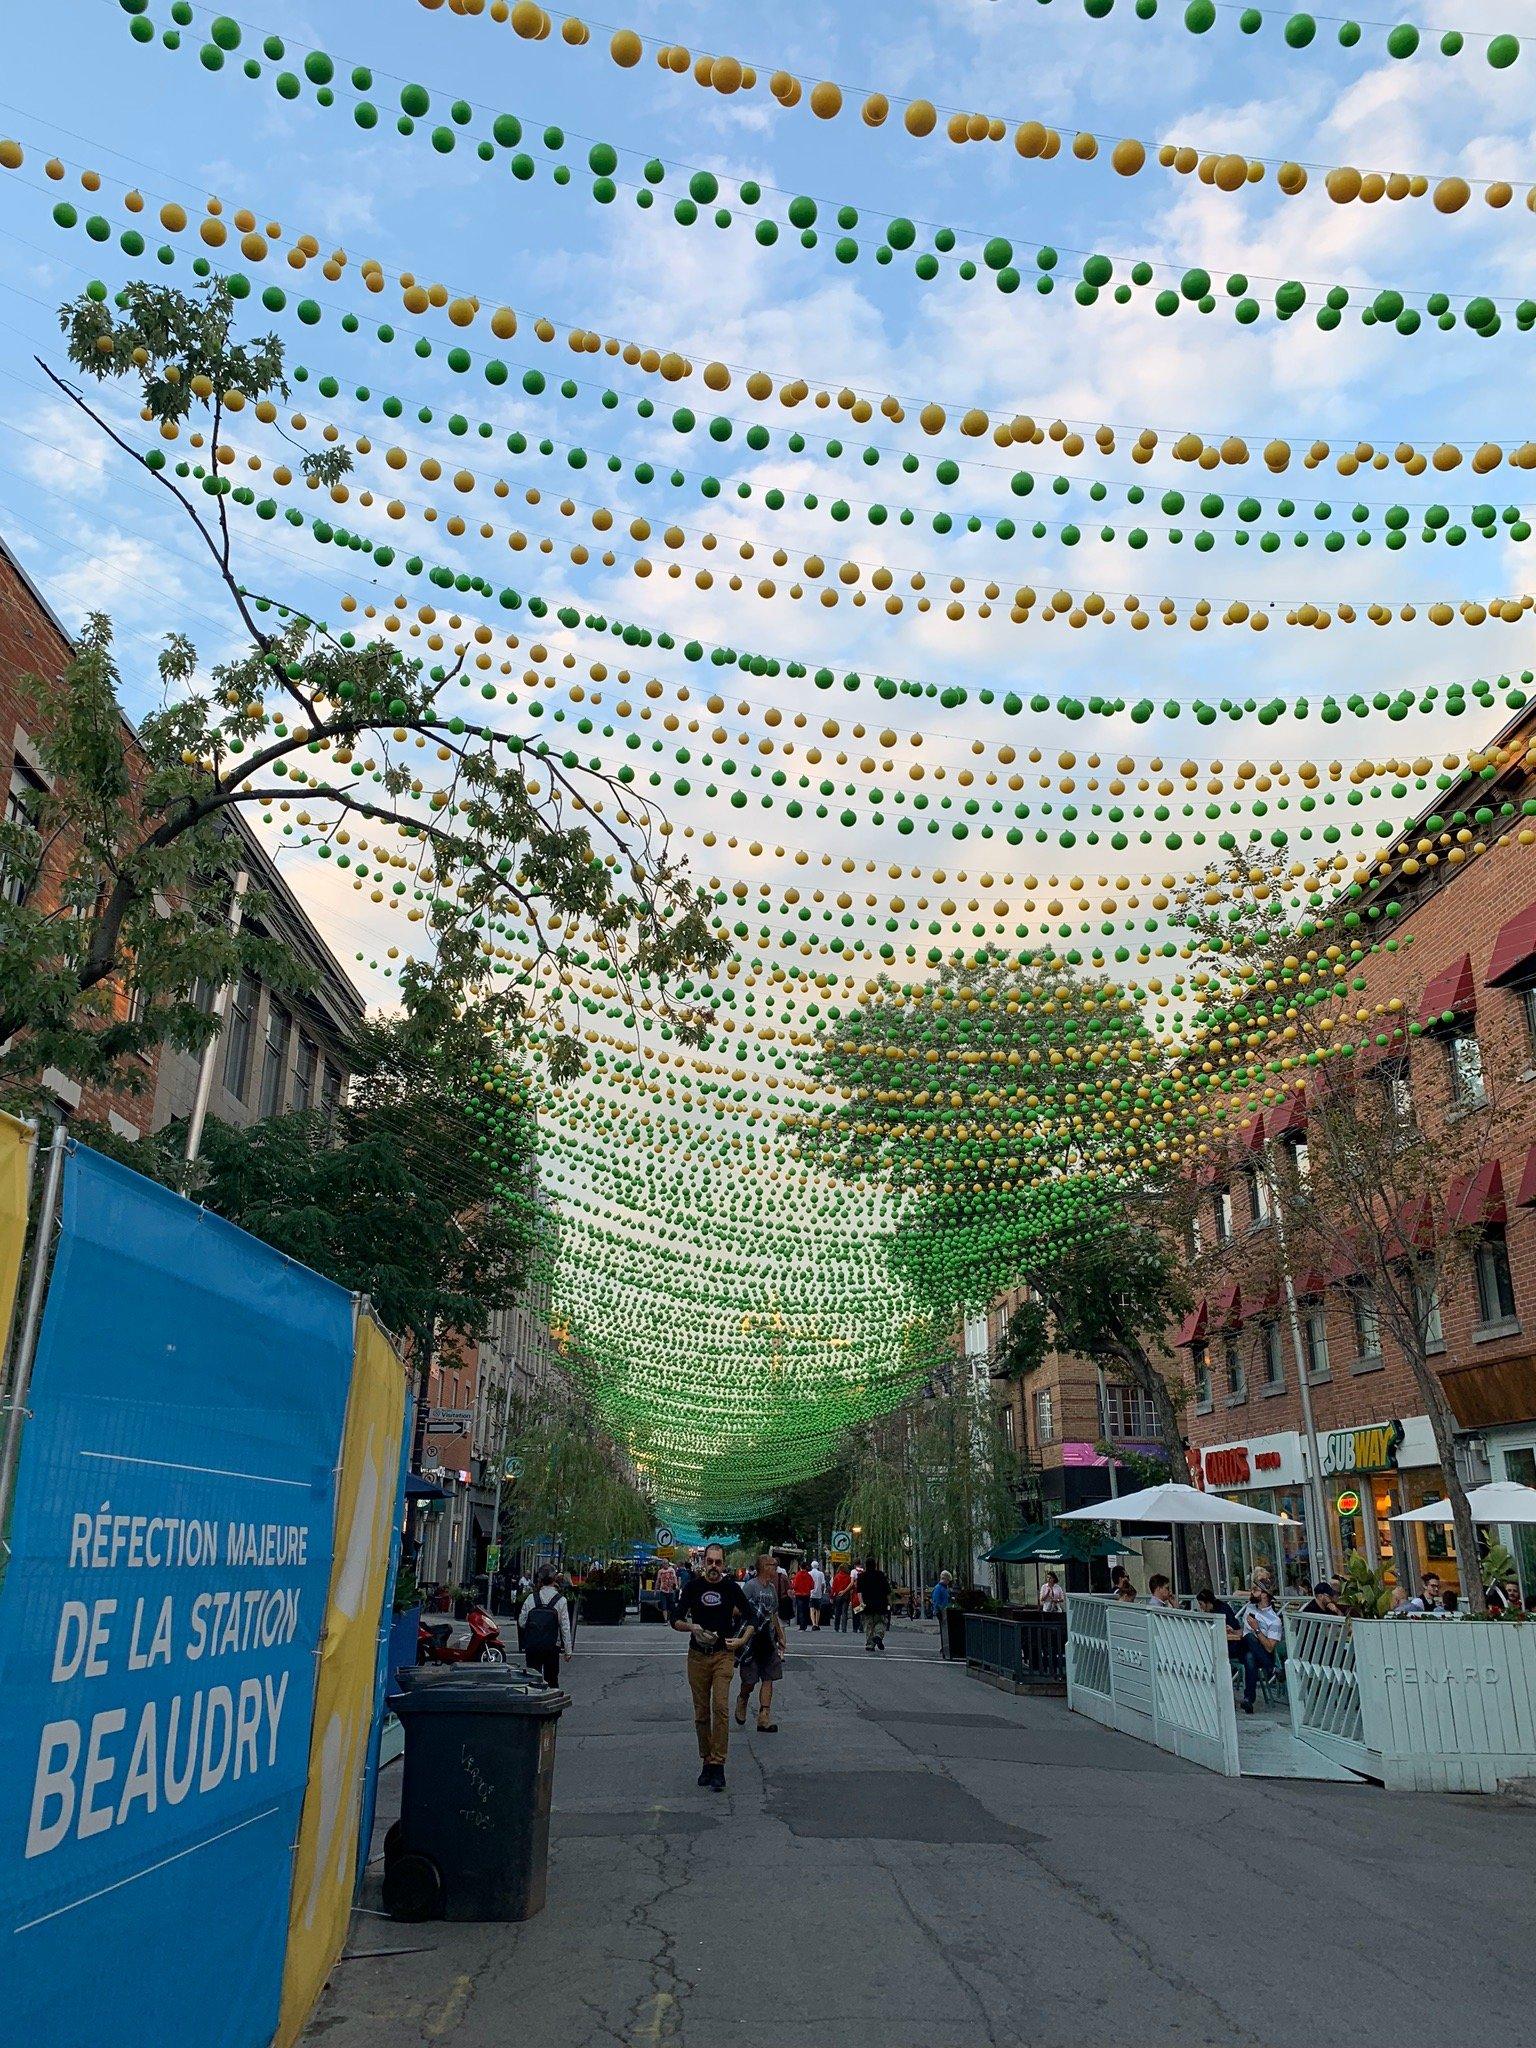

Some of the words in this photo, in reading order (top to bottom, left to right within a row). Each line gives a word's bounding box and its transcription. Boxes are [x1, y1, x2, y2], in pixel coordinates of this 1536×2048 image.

[1324, 1425, 1395, 1473] SUBWAY
[69, 1501, 217, 1568] RÉFECTION
[226, 1522, 308, 1566] MAJEURE
[52, 1599, 117, 1683] DE
[128, 1595, 173, 1671] LA
[187, 1588, 301, 1660] STATION
[1384, 1667, 1499, 1685] RENARD
[25, 1671, 289, 1859] BEAUDRY
